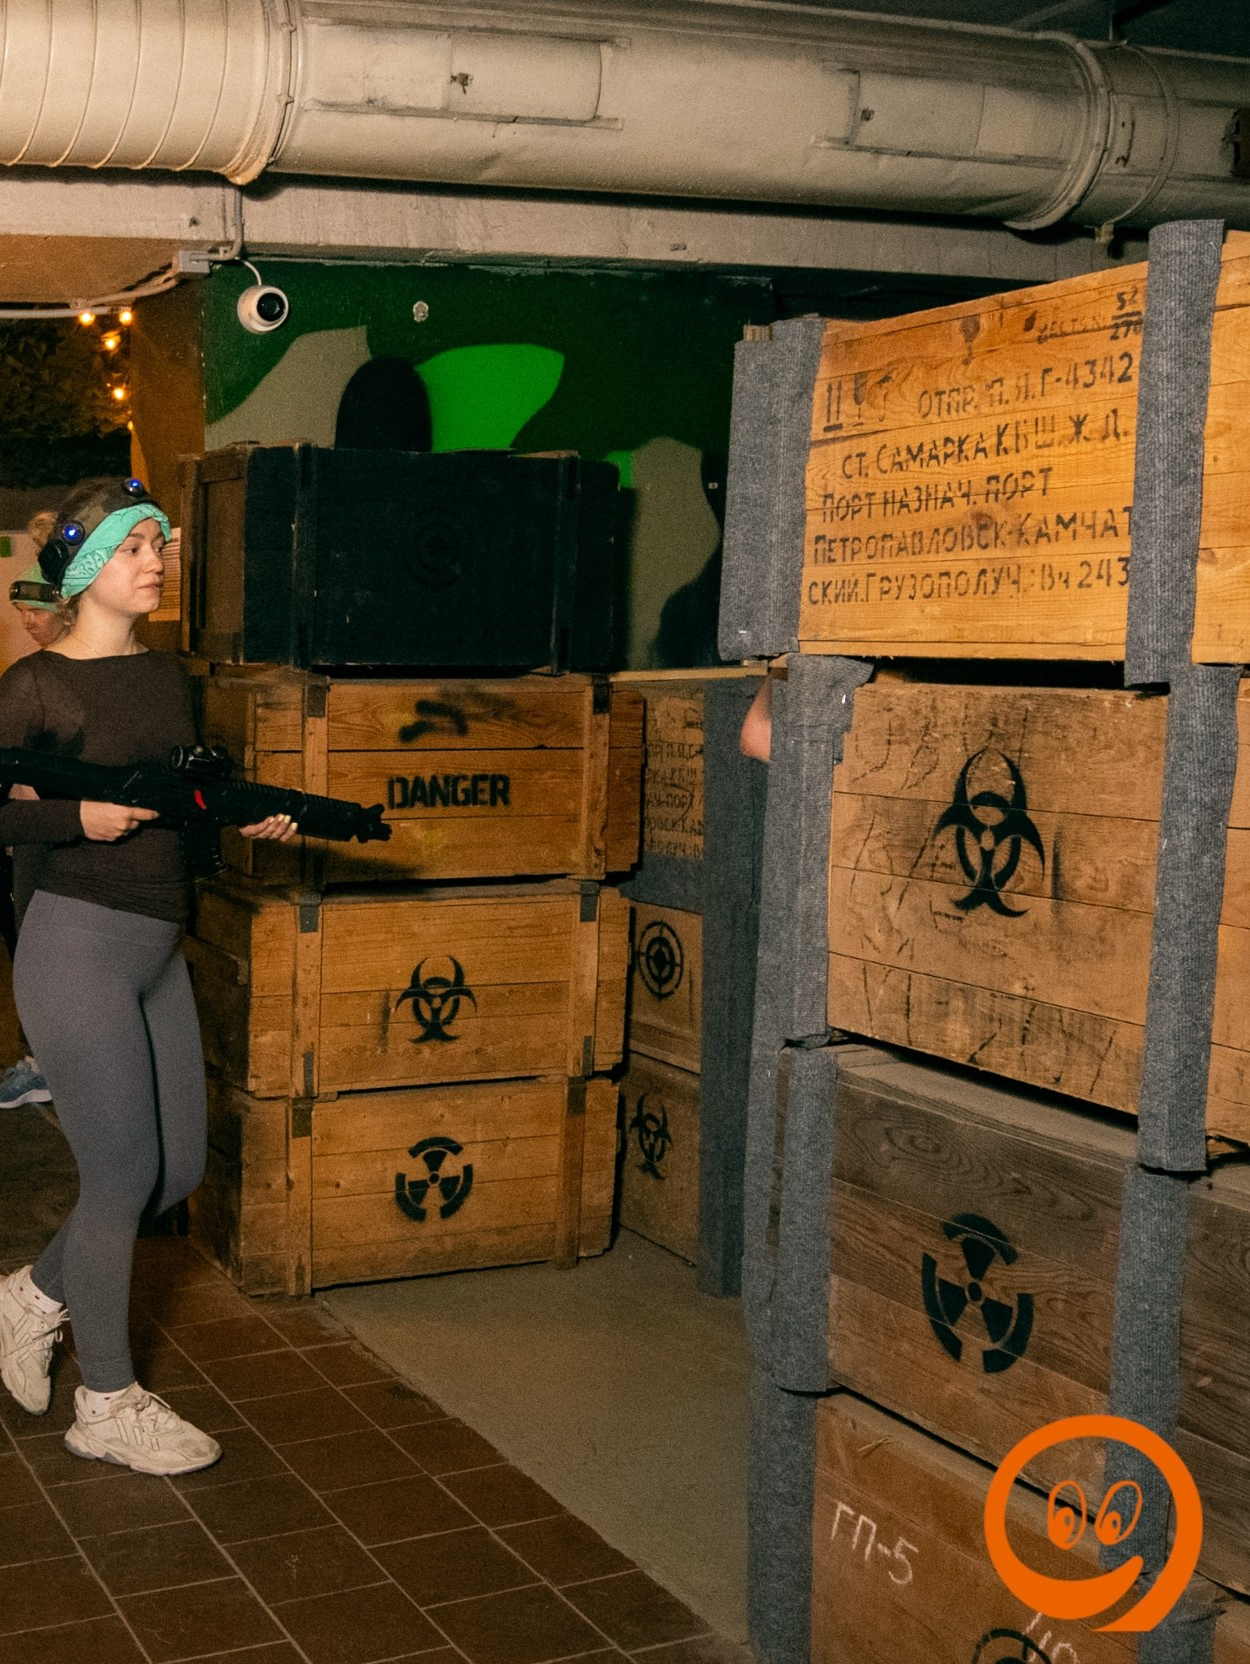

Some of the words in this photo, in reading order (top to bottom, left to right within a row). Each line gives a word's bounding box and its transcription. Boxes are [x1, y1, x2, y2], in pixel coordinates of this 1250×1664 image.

[823, 493, 876, 523] ПОРТ
[985, 466, 1053, 503] ПОРТ
[387, 774, 511, 809] DANGER
[831, 1501, 919, 1586] ГП-5
